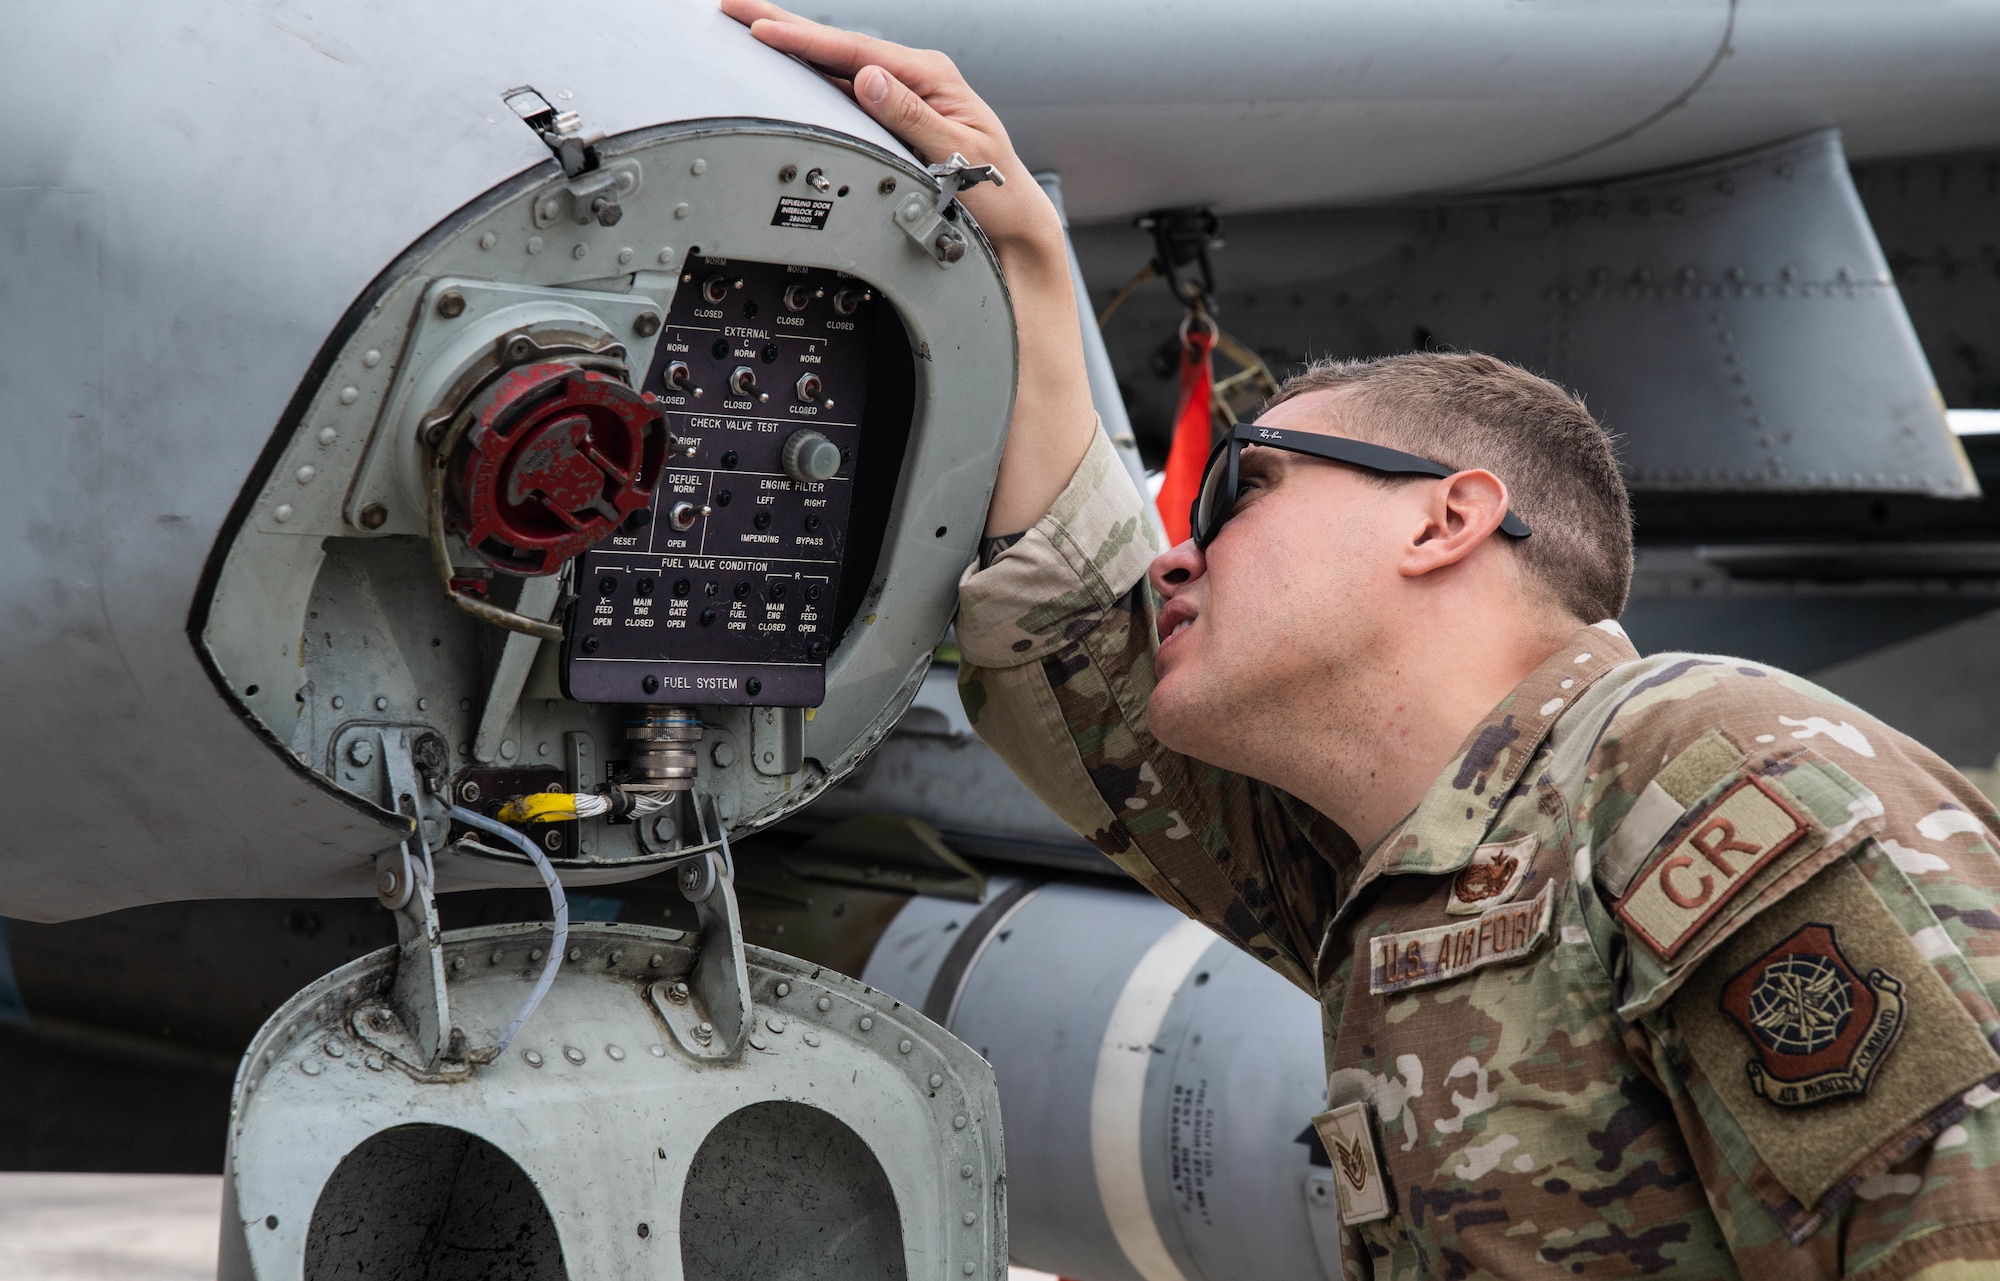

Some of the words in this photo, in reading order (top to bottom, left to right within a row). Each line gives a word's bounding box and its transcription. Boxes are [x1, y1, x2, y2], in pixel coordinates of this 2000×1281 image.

[781, 199, 811, 208] REFUELING
[812, 202, 831, 210] DOOR
[781, 207, 813, 216] INTERLOCK
[704, 257, 727, 266] NORM
[787, 265, 809, 274] NORM
[694, 308, 723, 319] CLOSED
[776, 316, 805, 327] CLOSED
[826, 321, 854, 331] CLOSED
[676, 333, 682, 342] L
[724, 327, 770, 340] EXTERNAL
[666, 343, 689, 353] NORM
[743, 339, 750, 348] C
[809, 345, 815, 353] R
[734, 349, 756, 359] NORM
[799, 354, 822, 364] NORM
[723, 400, 752, 411] CLOSED
[789, 405, 818, 416] CLOSED
[690, 418, 722, 430] CHECK
[725, 420, 752, 432] VALVE
[757, 422, 779, 433] TEST
[678, 436, 702, 447] RIGHT
[669, 474, 702, 486] DEFUEL
[673, 484, 695, 494] NORM
[760, 480, 791, 491] ENGINE
[794, 482, 825, 493] FILTER
[756, 496, 774, 505] LEFT
[804, 498, 826, 508] RIGHT
[613, 537, 637, 546] RESET
[667, 539, 686, 548] OPEN
[740, 534, 780, 544] IMPENDING
[796, 537, 823, 546] BYPASS
[626, 565, 632, 573] L
[661, 558, 684, 569] FUEL
[688, 559, 716, 570] VALVE
[719, 560, 768, 572] CONDITION
[794, 572, 801, 580] R
[600, 598, 611, 606] X-
[633, 598, 652, 607] MAIN
[670, 599, 689, 608] TANK
[733, 602, 747, 610] DE-
[595, 606, 613, 615] FEED
[634, 607, 649, 616] ENG
[766, 603, 785, 612] MAIN
[805, 604, 815, 612] X-
[669, 608, 687, 617] GATE
[729, 610, 747, 619] FUEL
[766, 611, 781, 620] ENG
[800, 612, 818, 621] FEED
[593, 618, 612, 626] OPEN
[625, 618, 654, 628] CLOSED
[666, 620, 686, 629] OPEN
[727, 622, 746, 631] OPEN
[758, 622, 787, 632] CLOSED
[798, 624, 817, 633] OPEN
[663, 677, 691, 689] FUEL
[696, 677, 738, 690] SYSTEM
[1660, 817, 1763, 909] CR
[1383, 940, 1425, 983] U.S.
[1436, 927, 1477, 973] AIR
[1778, 1087, 1799, 1101] AIR
[1857, 1009, 1896, 1068] COMMAND
